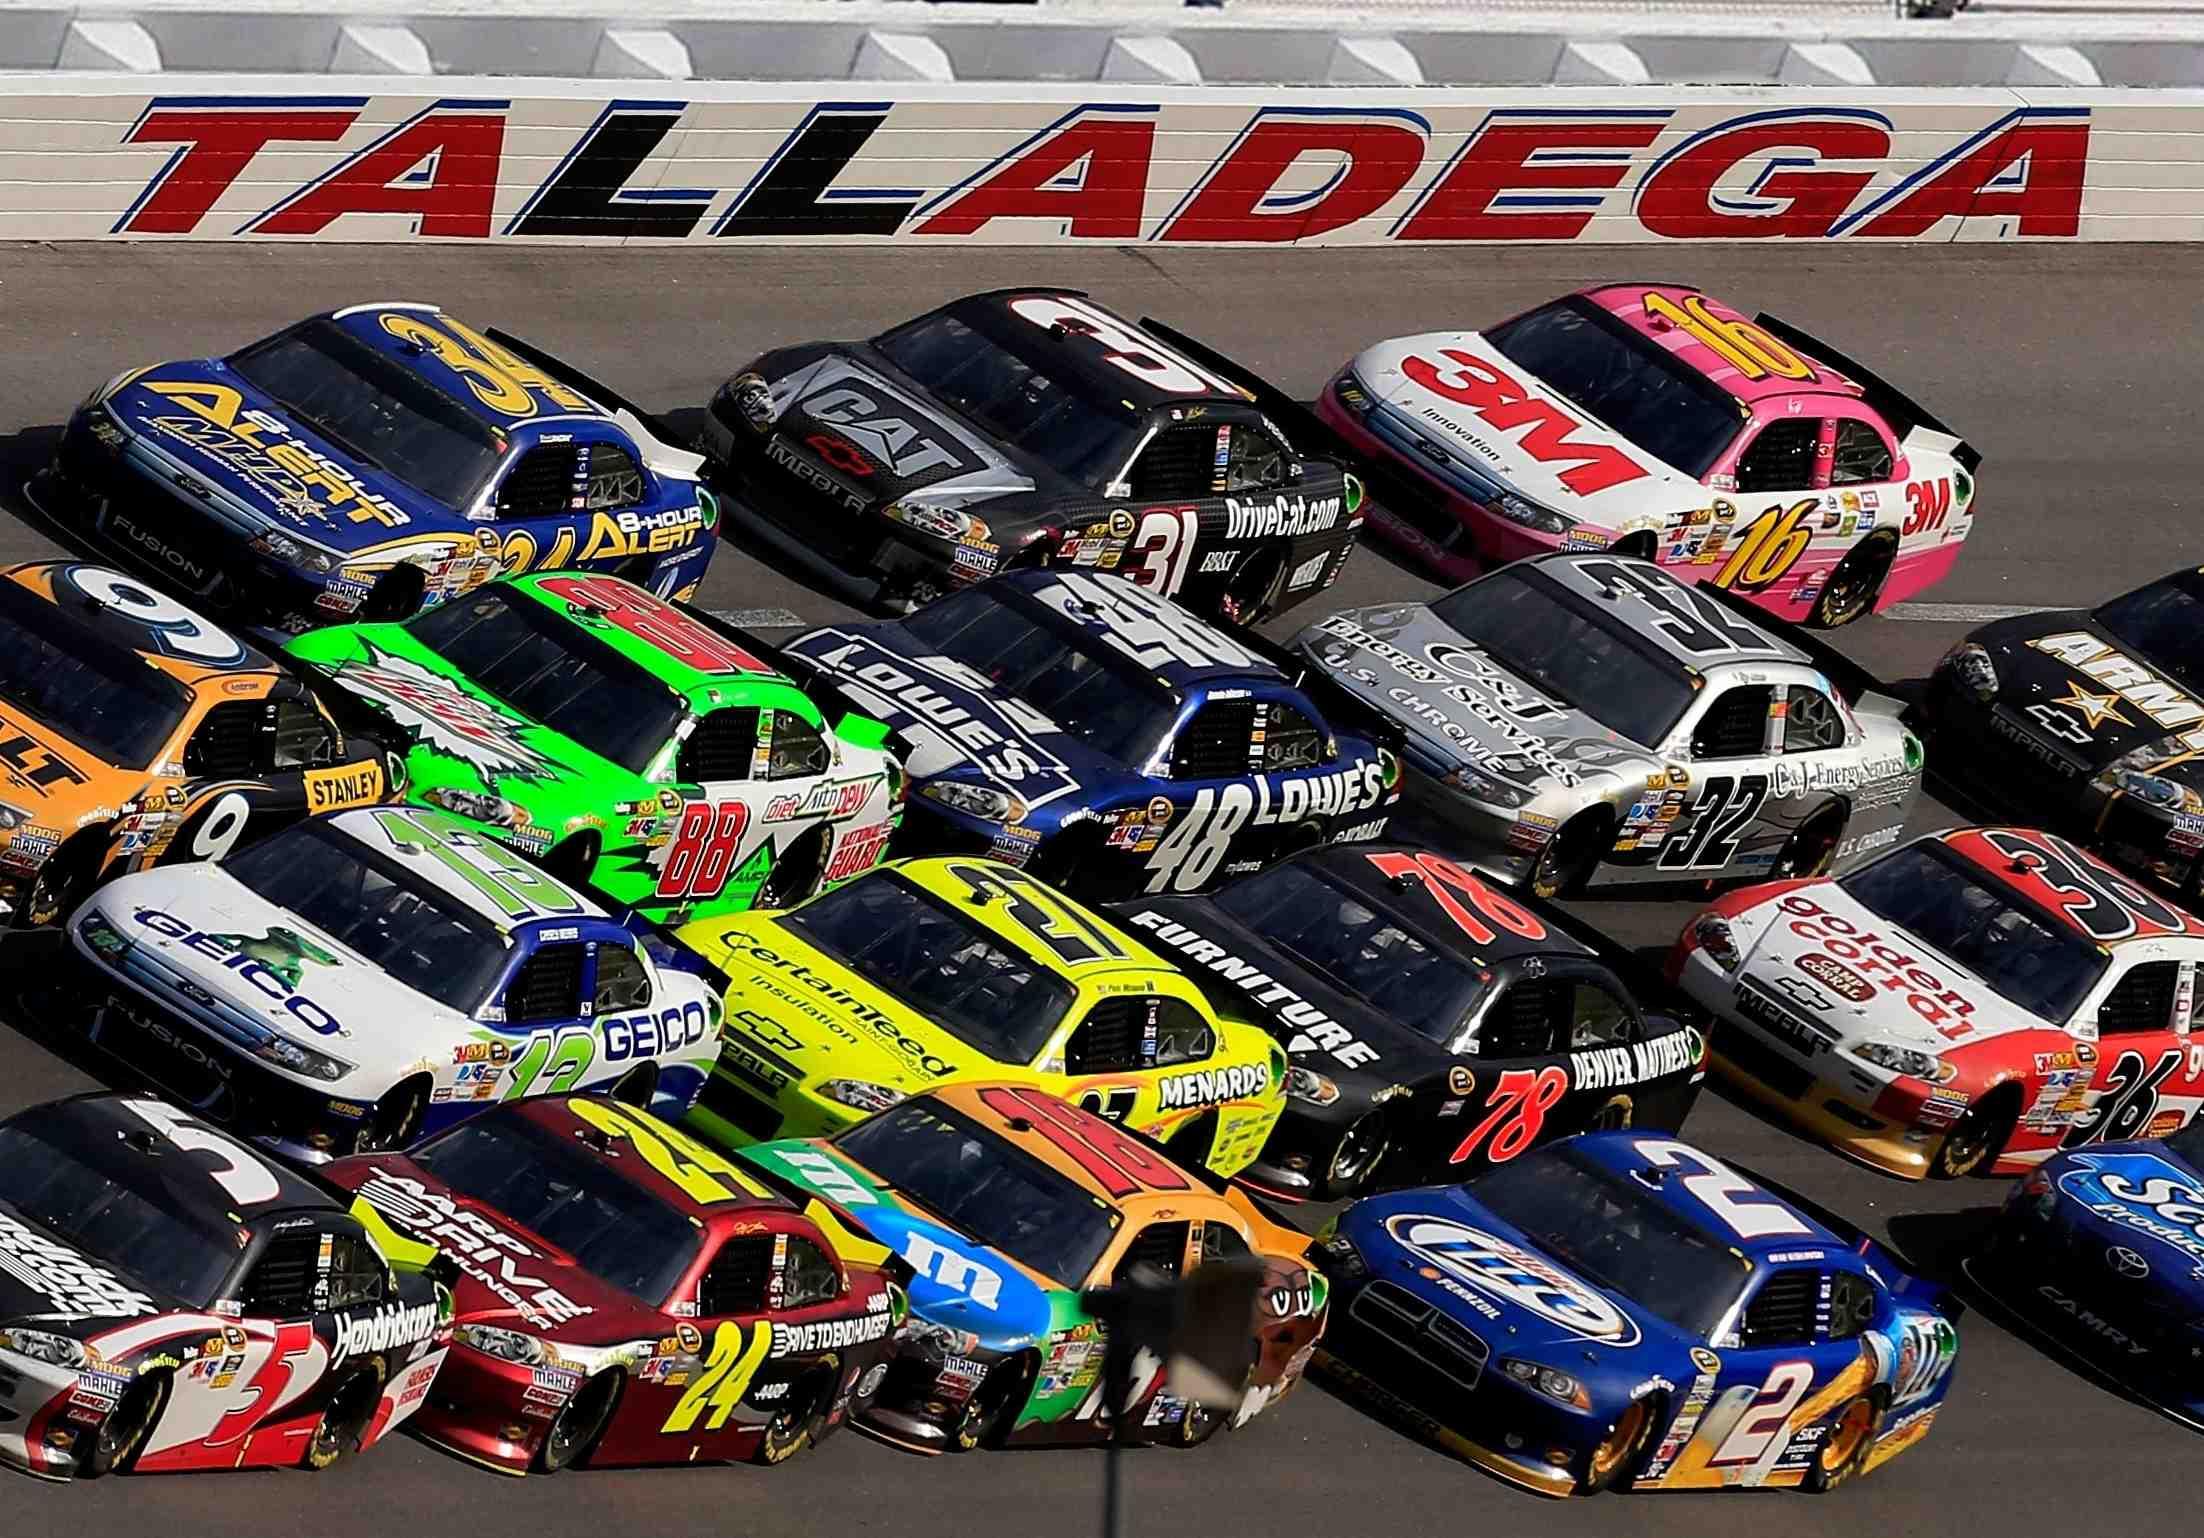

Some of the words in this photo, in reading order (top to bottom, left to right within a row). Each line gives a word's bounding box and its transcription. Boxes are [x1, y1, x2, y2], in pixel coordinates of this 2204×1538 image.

[110, 95, 2092, 245] TALLADEGA
[378, 311, 597, 418] 34
[1642, 290, 1817, 384] 16
[140, 382, 397, 528] ALERT
[801, 388, 964, 479] CAT
[1400, 347, 1651, 498] 3M
[1421, 407, 1501, 463] Innovation
[240, 409, 412, 527] 8-HOUR
[1902, 477, 1951, 537] 3M
[112, 515, 205, 580] FUSION
[575, 511, 702, 561] ALERT
[616, 505, 702, 533] 8-HOUR
[958, 534, 1001, 555] MOOG
[1131, 508, 1200, 600] 31
[1224, 495, 1341, 540] DriveCat.com
[1713, 498, 1820, 592] 16
[954, 549, 998, 572] MAHLE
[1200, 550, 1240, 573] BB&T
[66, 565, 248, 668] 9
[1571, 559, 1786, 656] 32
[818, 645, 1050, 781] LOWE'S
[1313, 615, 1454, 685] Energy
[1442, 680, 1582, 789] Services
[1323, 653, 1381, 688] U.S.
[1387, 687, 1510, 774] CHROME
[1424, 643, 1569, 722] C&J
[313, 772, 379, 808] STANLEY
[767, 797, 800, 820] diet
[1252, 757, 1383, 826] LOWE'S
[1815, 755, 1863, 790] Energy
[10, 838, 52, 856] MAHLE
[21, 824, 62, 844] MOOG
[192, 792, 250, 864] 9
[373, 807, 586, 917] 13
[512, 823, 553, 841] MOOG
[655, 800, 751, 897] 88
[825, 837, 889, 881] GUARD
[1003, 823, 1041, 841] MOOG
[1143, 783, 1254, 894] 48
[1655, 774, 1770, 872] 32
[946, 862, 1134, 967] 27
[1363, 852, 1547, 945] 78
[1981, 830, 2187, 942] 36
[133, 909, 342, 1036] GEICO
[1129, 910, 1382, 1069] FURNITURE
[1776, 896, 1977, 1019] golden
[1788, 920, 1975, 1042] corral
[1801, 960, 1862, 1001] CORRAL
[1815, 957, 1866, 991] CAMP
[107, 994, 234, 1079] FUSION
[602, 1000, 707, 1063] GEICO
[718, 930, 958, 1077] CertainTeed
[749, 975, 859, 1044] Insulation
[722, 1038, 790, 1089] PALA
[1157, 1062, 1270, 1111] MENARDS
[1570, 1046, 1635, 1091] DENVER
[1632, 1029, 1696, 1083] MATTRESS
[1930, 1086, 1970, 1102] MOOG
[2053, 1050, 2185, 1151] 36
[120, 1098, 281, 1206] 5
[566, 1096, 776, 1205] 24
[978, 1087, 1192, 1197] 18
[1448, 1065, 1569, 1165] 78
[368, 1165, 544, 1261] AARP
[1632, 1139, 1817, 1238] 2
[2093, 1201, 2204, 1260] Produc
[357, 1178, 596, 1324] DRIVE
[440, 1247, 555, 1332] HUNGER
[904, 1231, 1002, 1311] m
[1435, 1276, 1502, 1321] PENNZOIL
[2037, 1286, 2148, 1354] CAMRY
[78, 1374, 123, 1396] MAHLE
[90, 1358, 133, 1378] MOOG
[202, 1320, 318, 1448] 5
[533, 1368, 577, 1393] MAHLE
[659, 1319, 773, 1433] 24
[754, 1382, 792, 1401] AARP
[945, 1356, 989, 1378] MAHLE
[1705, 1360, 1814, 1469] 2
[1798, 1426, 1827, 1441] SKF
